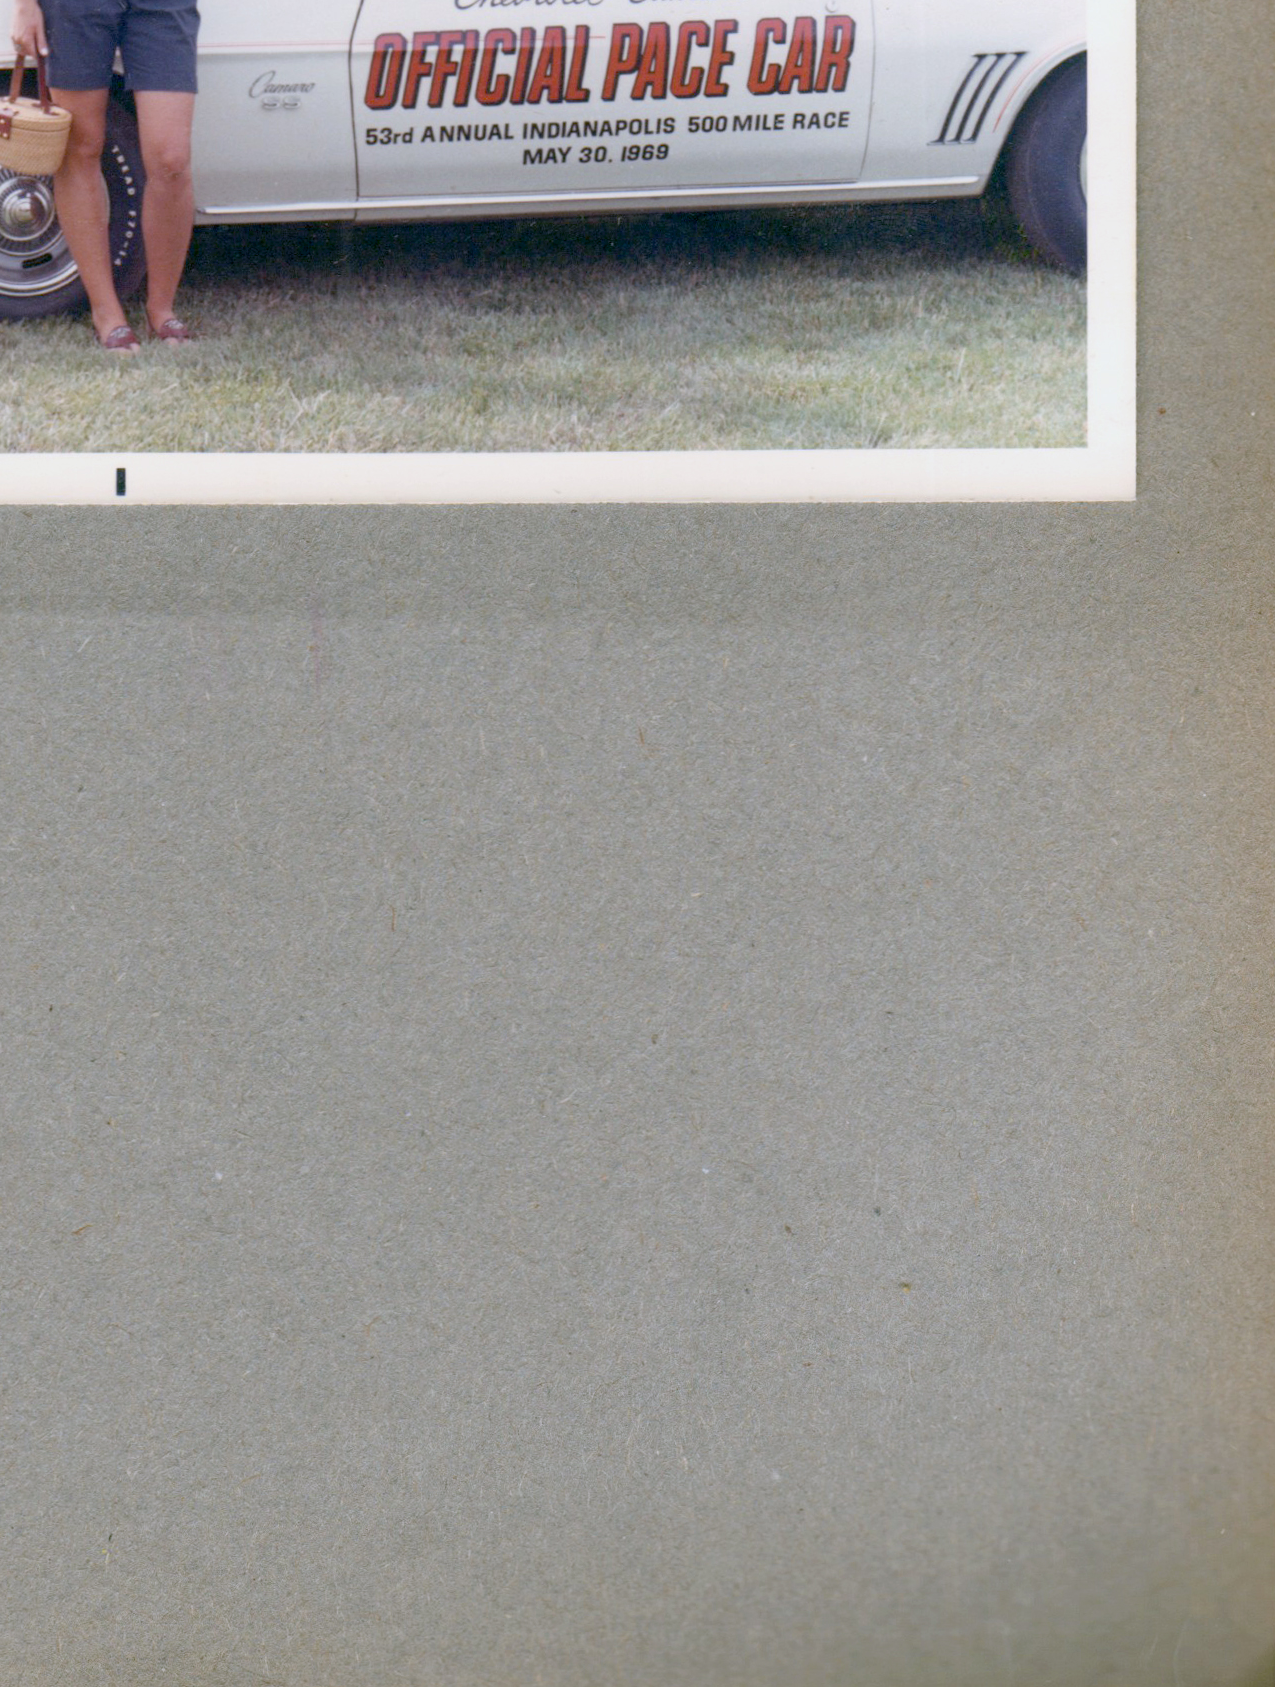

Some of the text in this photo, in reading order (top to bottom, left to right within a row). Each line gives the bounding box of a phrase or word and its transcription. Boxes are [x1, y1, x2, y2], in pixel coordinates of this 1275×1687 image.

[364, 15, 856, 110] OFFICIAL PACE CAR
[248, 70, 316, 98] Camaro
[261, 96, 302, 112] SS
[365, 111, 851, 146] 53rd ANNUAL INDIANAPOLIS 500 MILE RACE
[523, 148, 572, 166] MAY
[621, 143, 670, 162] 1969
